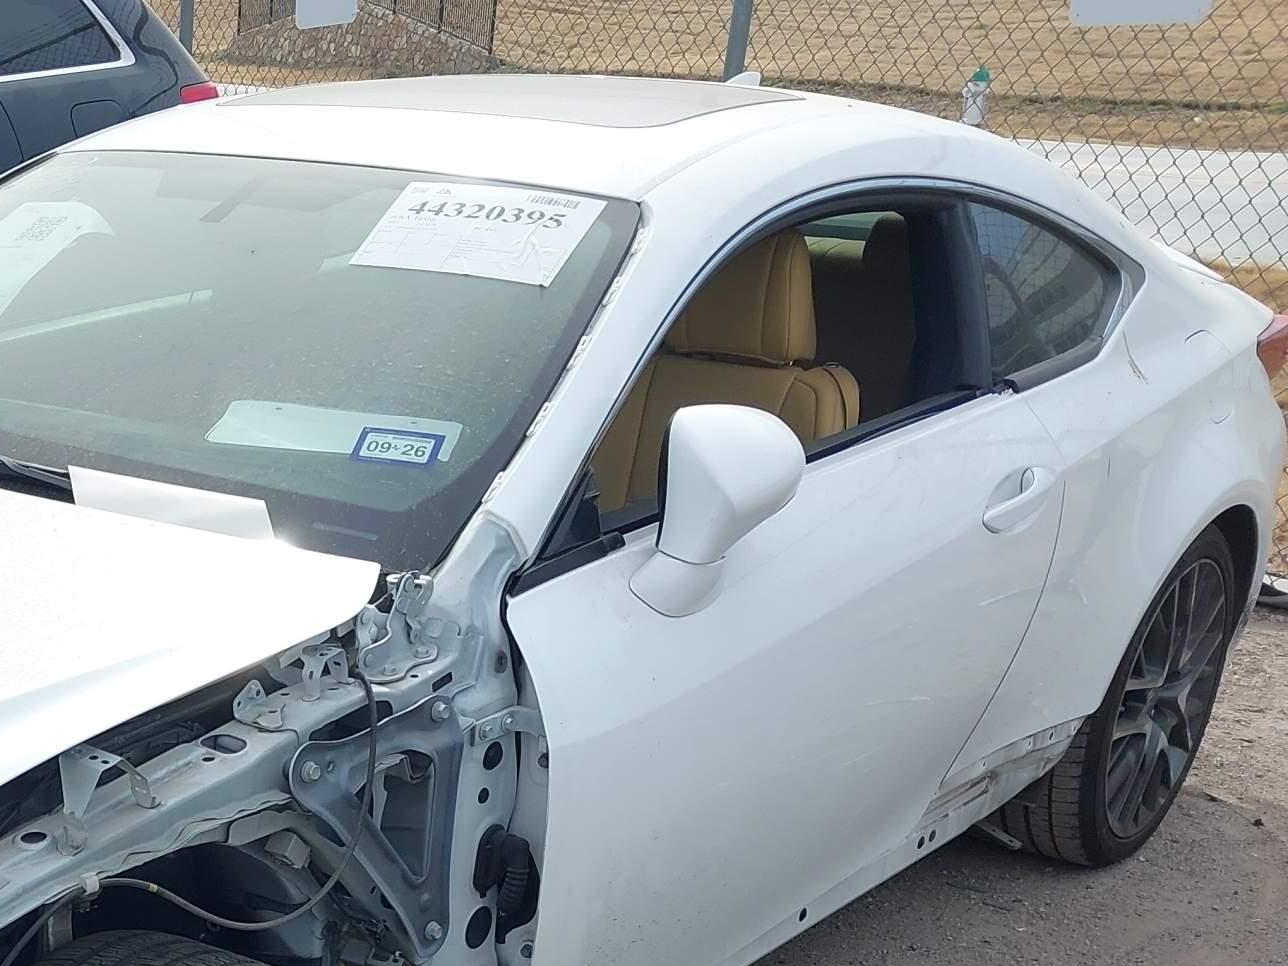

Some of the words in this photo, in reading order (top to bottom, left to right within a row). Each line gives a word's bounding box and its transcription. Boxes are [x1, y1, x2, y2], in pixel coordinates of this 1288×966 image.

[407, 199, 568, 229] 44320395
[366, 440, 392, 453] 09
[401, 443, 428, 458] 26
